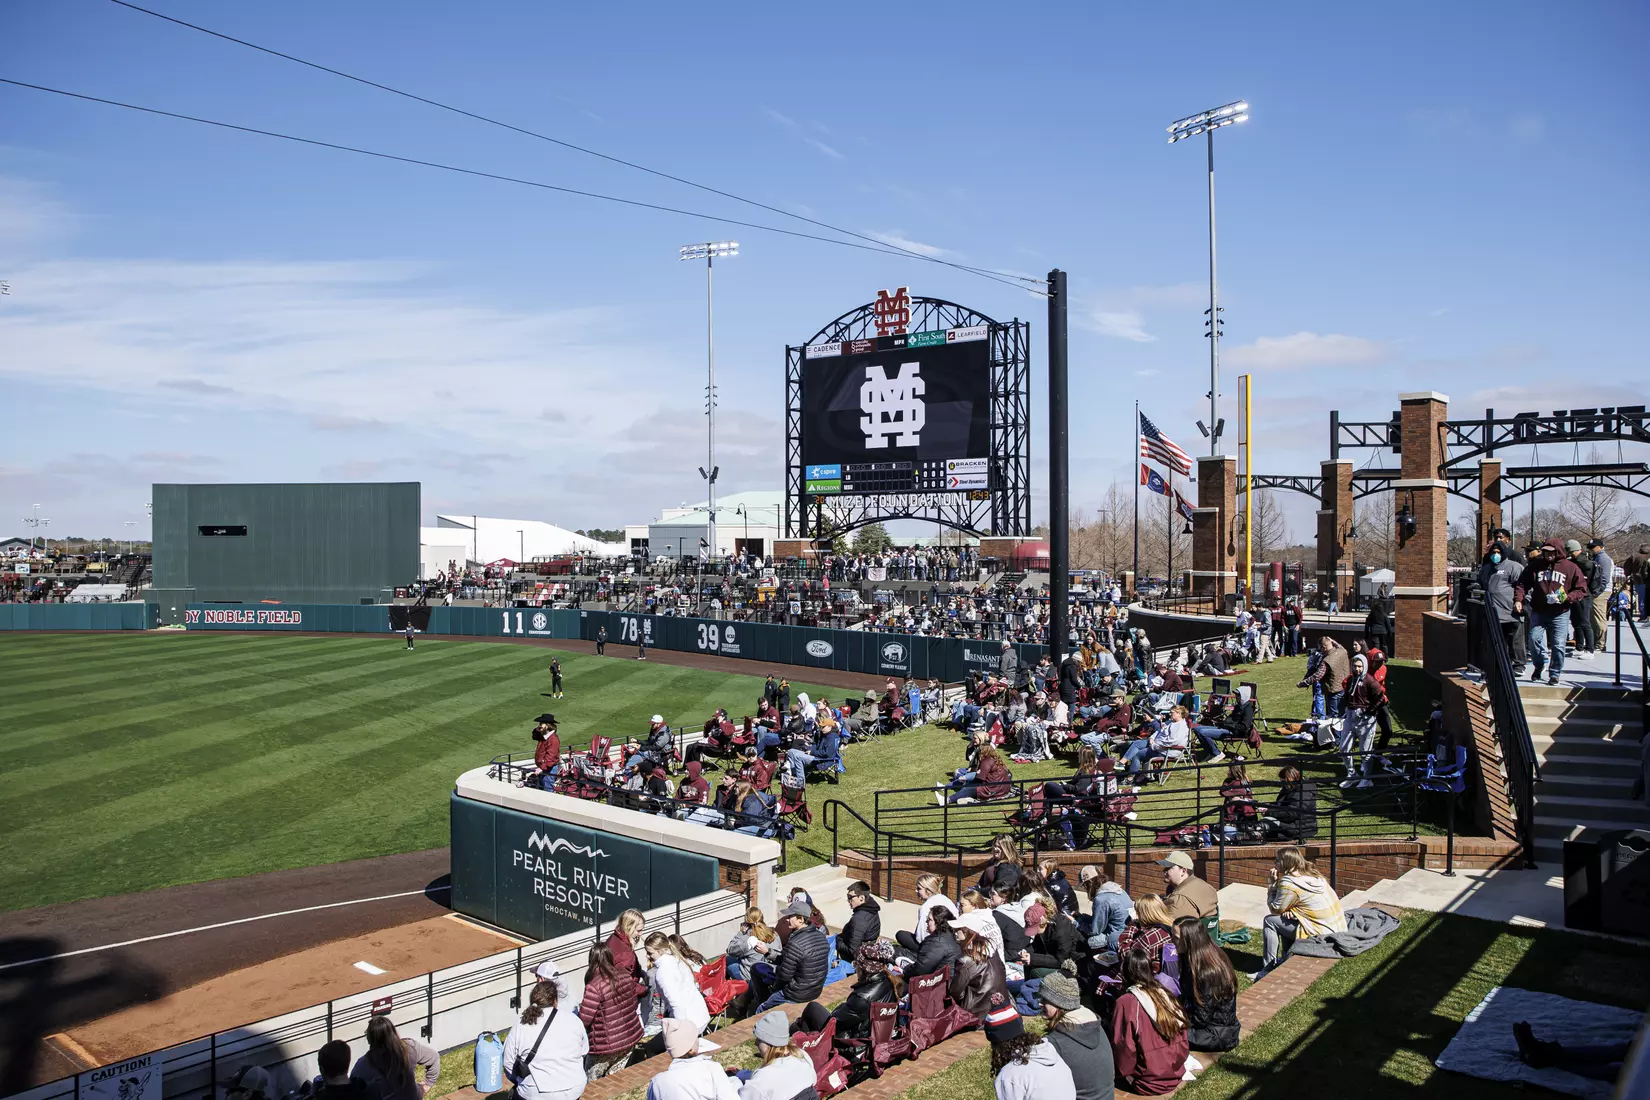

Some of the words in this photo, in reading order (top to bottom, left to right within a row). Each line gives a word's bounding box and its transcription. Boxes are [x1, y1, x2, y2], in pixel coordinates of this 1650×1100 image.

[918, 333, 930, 341] First
[931, 331, 945, 340] South
[957, 330, 987, 338] LEARFIELD
[813, 343, 840, 353] CADENCE
[828, 495, 864, 508] MIZE
[868, 492, 967, 508] FOUNDATION
[970, 491, 988, 500] 12:43
[1537, 570, 1567, 586] STE
[204, 610, 254, 623] NOBLE
[257, 610, 302, 624] FIELD
[621, 617, 638, 641] 78
[697, 623, 719, 650] 39
[810, 642, 828, 654] Ford
[970, 653, 1000, 663] RENASANT
[513, 849, 568, 881] PEARL
[573, 867, 630, 899] RIVER
[533, 877, 606, 914] RESORT
[545, 903, 581, 922] CHOCTAW,
[583, 915, 594, 925] MS
[91, 1056, 151, 1082] CAUTION!
